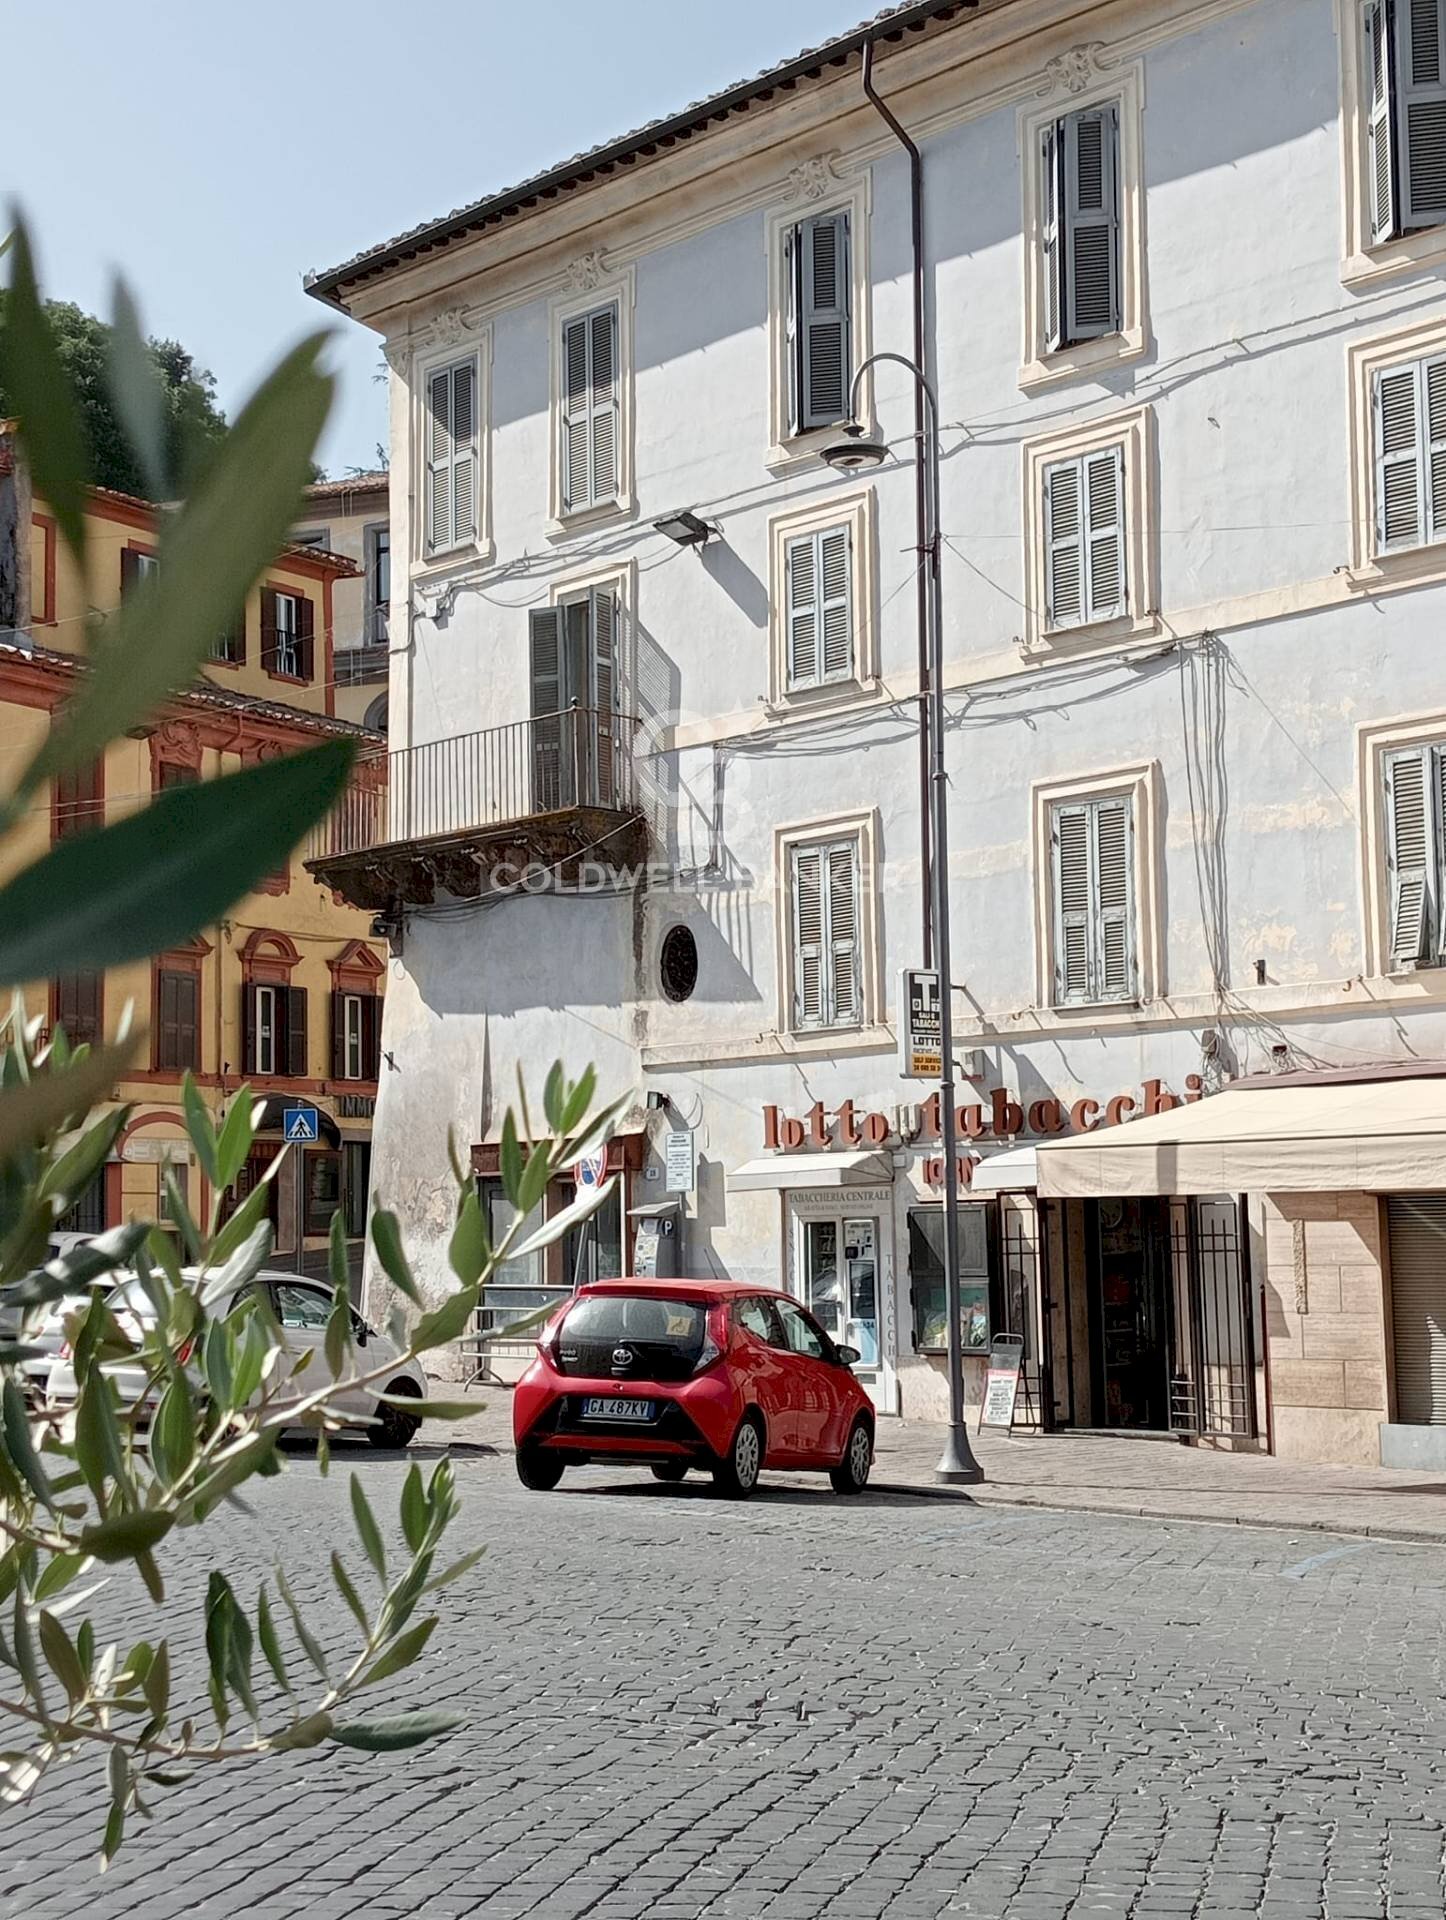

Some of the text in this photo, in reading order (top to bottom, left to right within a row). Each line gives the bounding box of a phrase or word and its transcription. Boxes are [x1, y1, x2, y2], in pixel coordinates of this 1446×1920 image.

[914, 974, 937, 1011] T
[913, 1036, 941, 1046] LOTTO
[763, 1074, 1203, 1149] lotto tabacchi
[789, 1190, 891, 1203] TABACCHERIA CENTRALE
[664, 1220, 673, 1236] P
